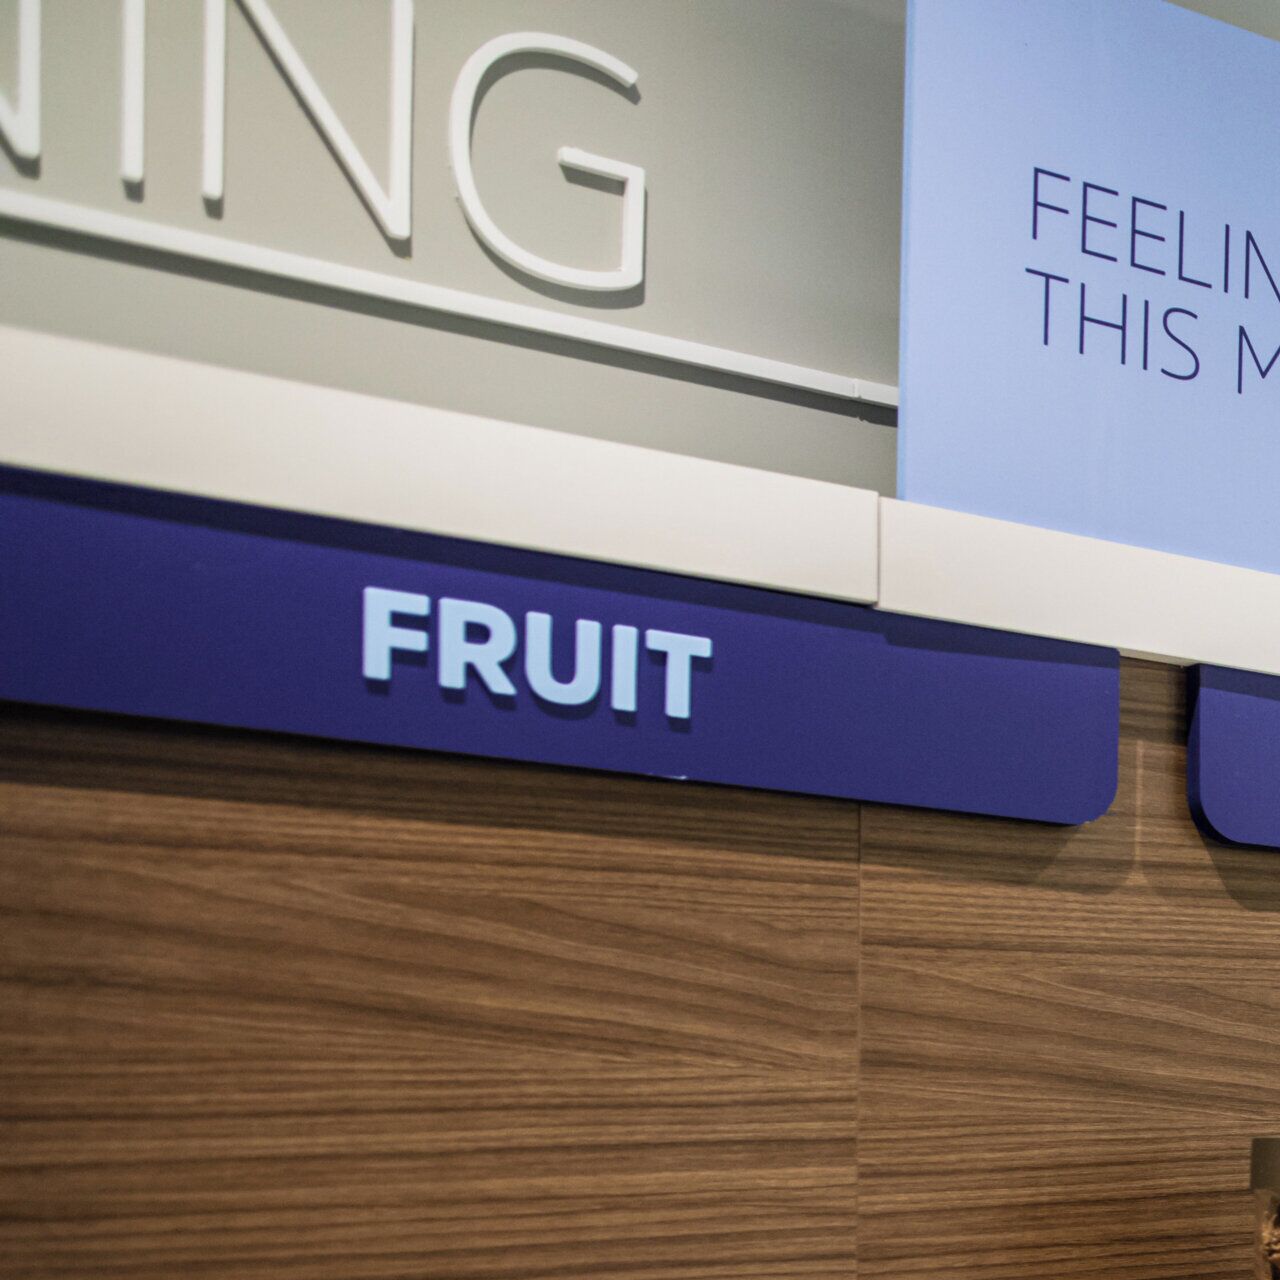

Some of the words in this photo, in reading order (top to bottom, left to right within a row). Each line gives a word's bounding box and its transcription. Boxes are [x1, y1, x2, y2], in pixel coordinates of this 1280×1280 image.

[0, 0, 646, 292] ING
[1024, 266, 1201, 382] THIS
[361, 585, 713, 720] FRUIT
